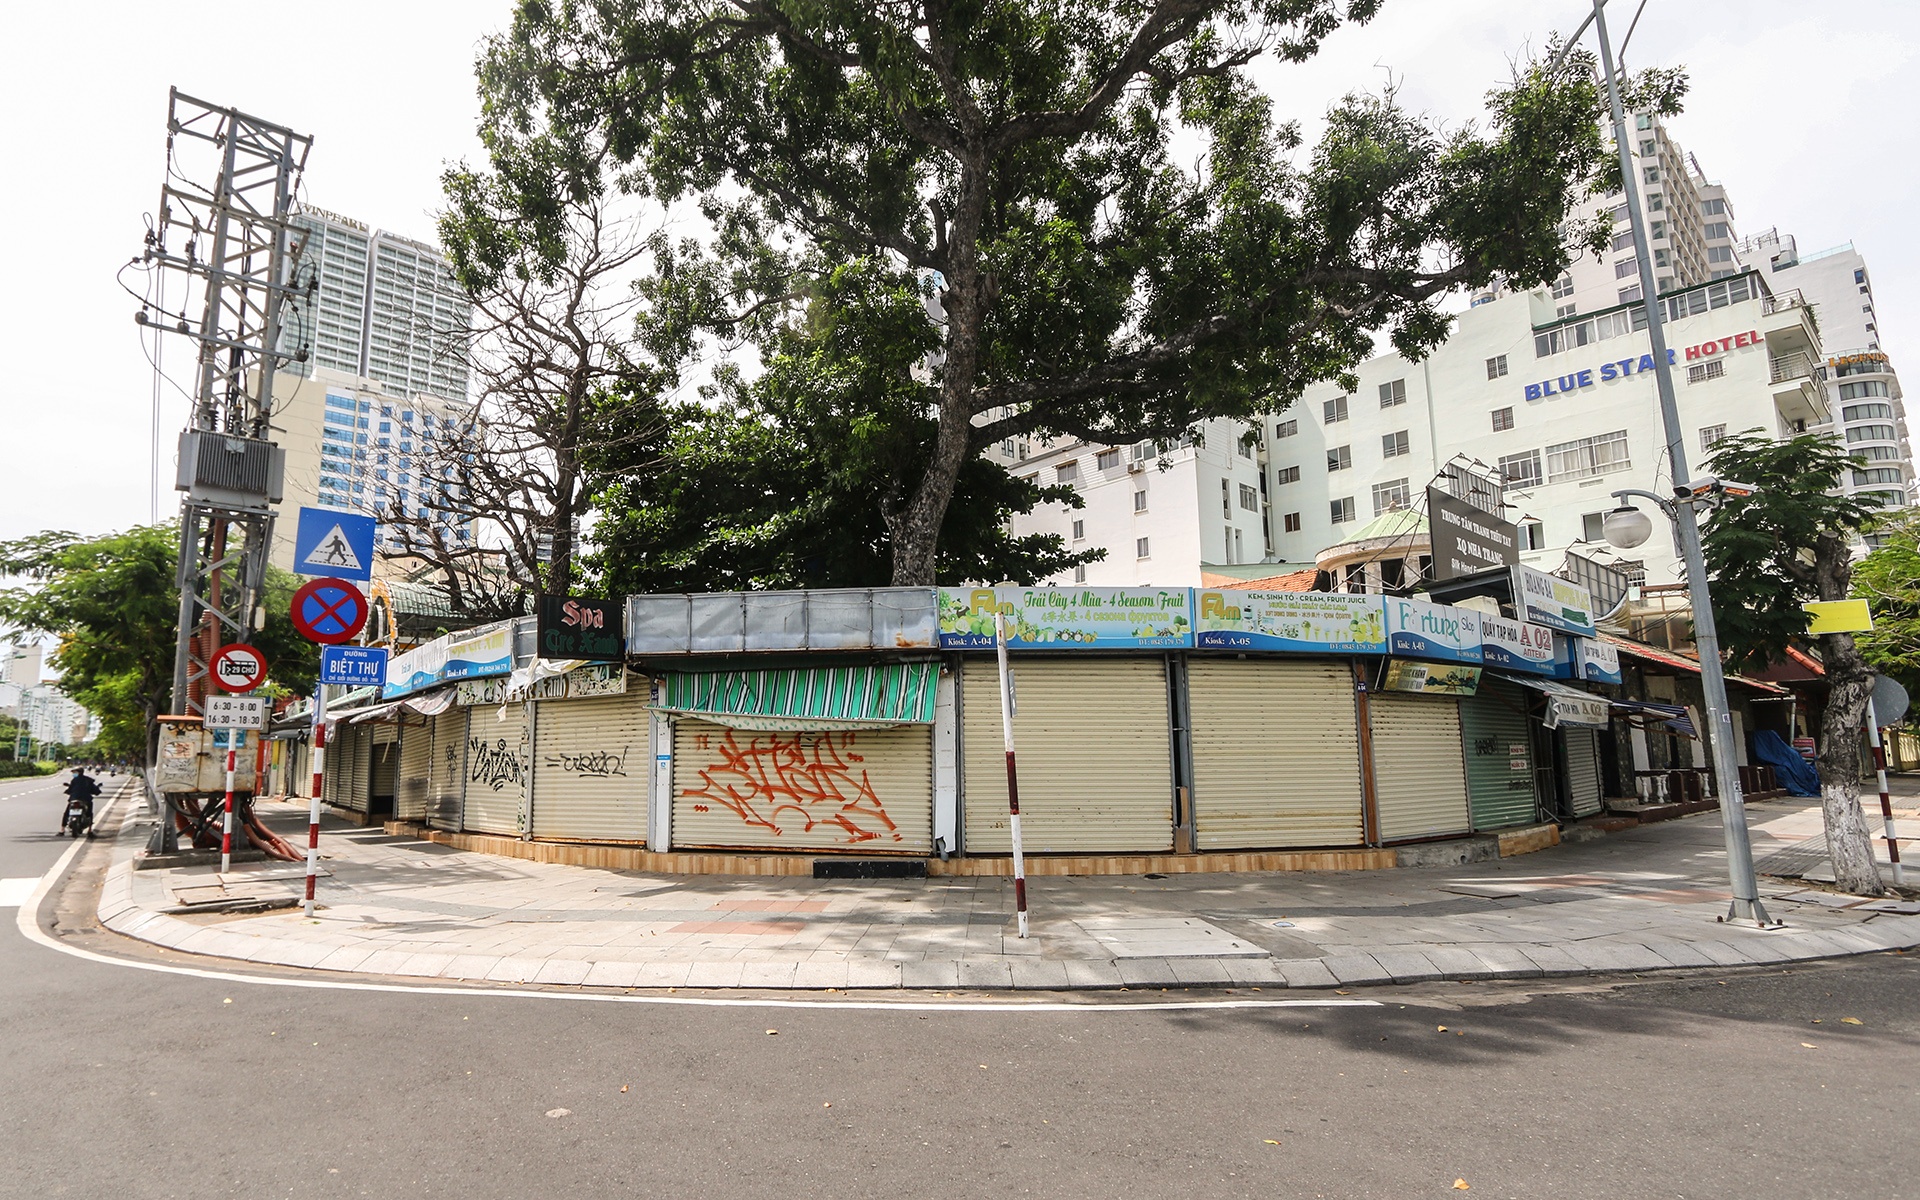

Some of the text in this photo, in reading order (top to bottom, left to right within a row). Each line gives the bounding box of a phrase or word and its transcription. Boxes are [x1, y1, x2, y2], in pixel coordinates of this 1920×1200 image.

[303, 202, 368, 232] VINPEARL
[1525, 330, 1764, 401] BLUE STAR HOTEL
[1441, 508, 1460, 526] TRUNG
[1456, 536, 1504, 566] XQ NHA TRANG
[1024, 590, 1046, 608] Trái
[1048, 590, 1067, 611] Cây
[1070, 592, 1077, 607] 4
[1078, 591, 1101, 607] Mùa
[1109, 592, 1116, 607] 4
[1117, 591, 1155, 607] Seasons
[1157, 590, 1184, 611] Fruit
[1201, 592, 1241, 620] F4m
[1247, 593, 1265, 601] KEM,
[1299, 595, 1326, 603] CREAM,
[561, 600, 604, 631] Spa
[545, 629, 575, 656] Tre
[948, 638, 992, 646] Kiosk: A-04
[1205, 637, 1251, 646] Kiosk: A-05
[1520, 625, 1532, 647] A
[1534, 628, 1552, 651] 02
[344, 650, 367, 658] ĐƯỜNG
[330, 657, 379, 677] BIỆT THỰ
[213, 702, 231, 711] 6:30
[239, 702, 256, 711] 8:00
[1582, 702, 1590, 715] A
[1590, 703, 1603, 717] 02
[208, 715, 230, 723] 16:30
[239, 716, 260, 724] 18:30
